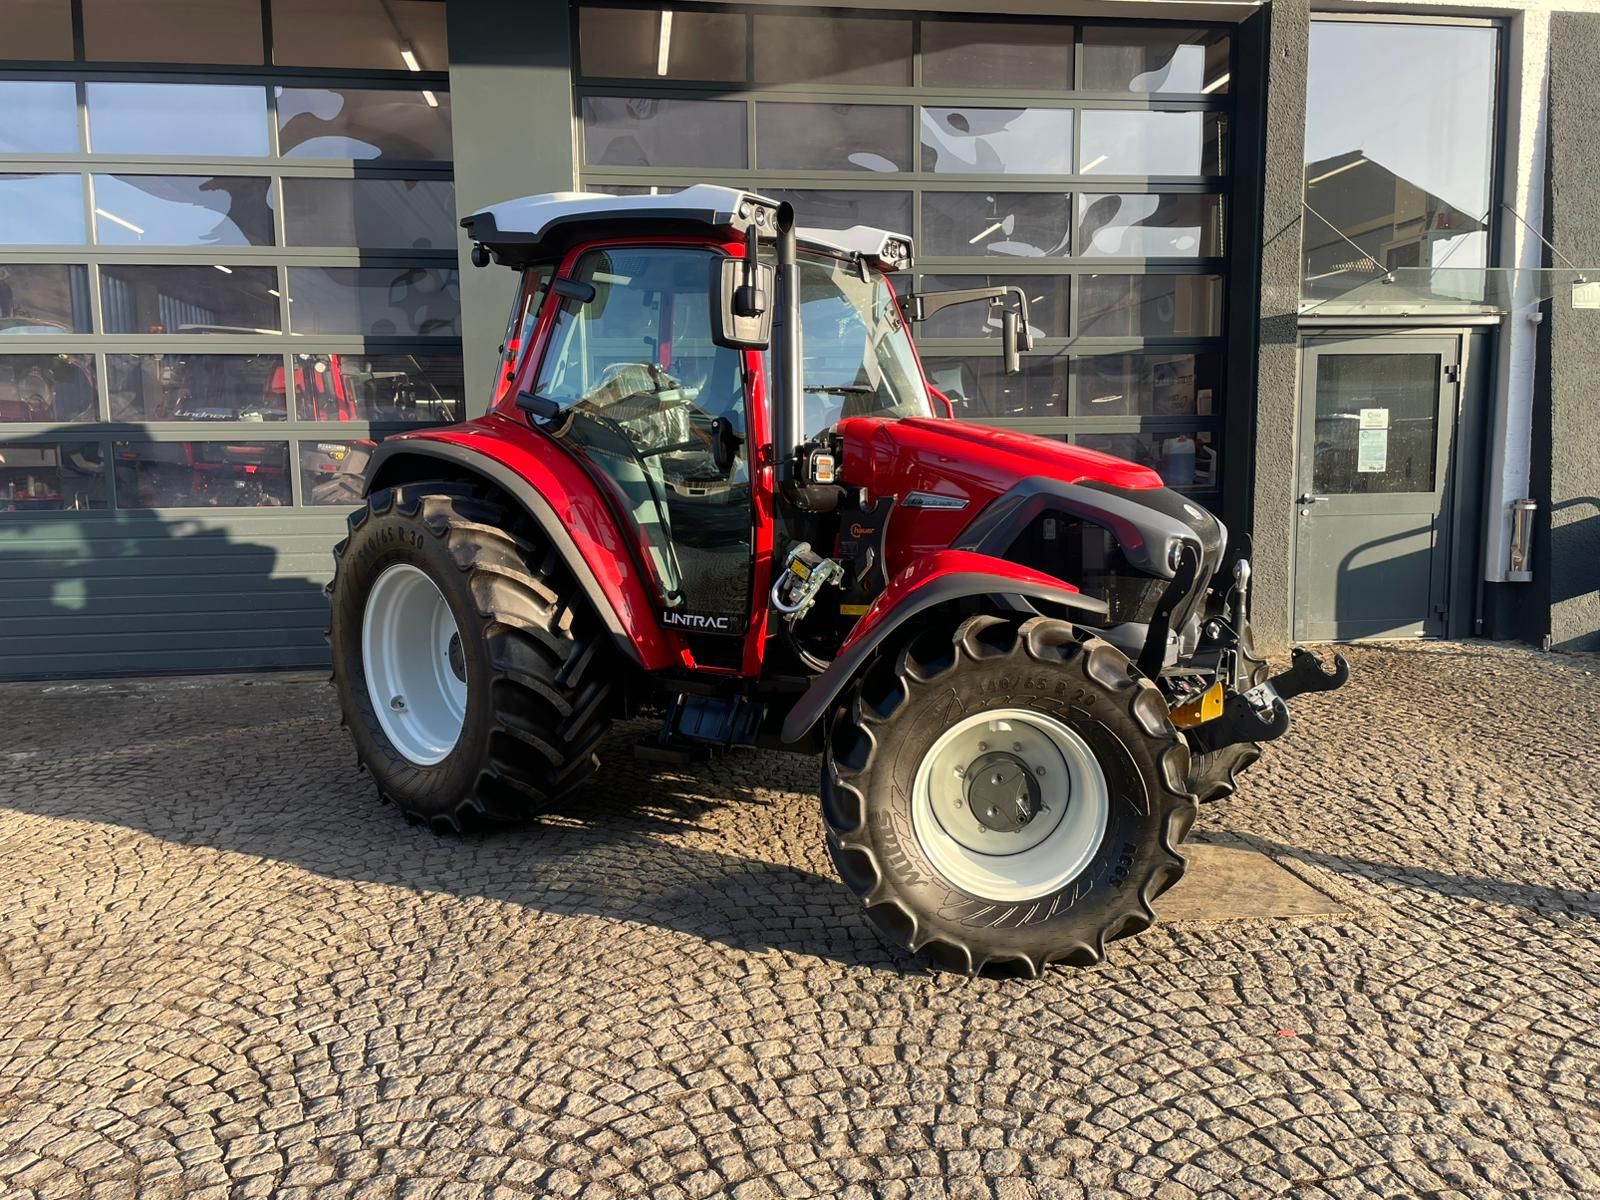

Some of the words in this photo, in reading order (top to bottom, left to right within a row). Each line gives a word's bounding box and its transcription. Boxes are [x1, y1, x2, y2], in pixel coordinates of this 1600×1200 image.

[409, 529, 424, 550] 30
[663, 611, 729, 628] LINTRAC
[1075, 688, 1097, 706] 20
